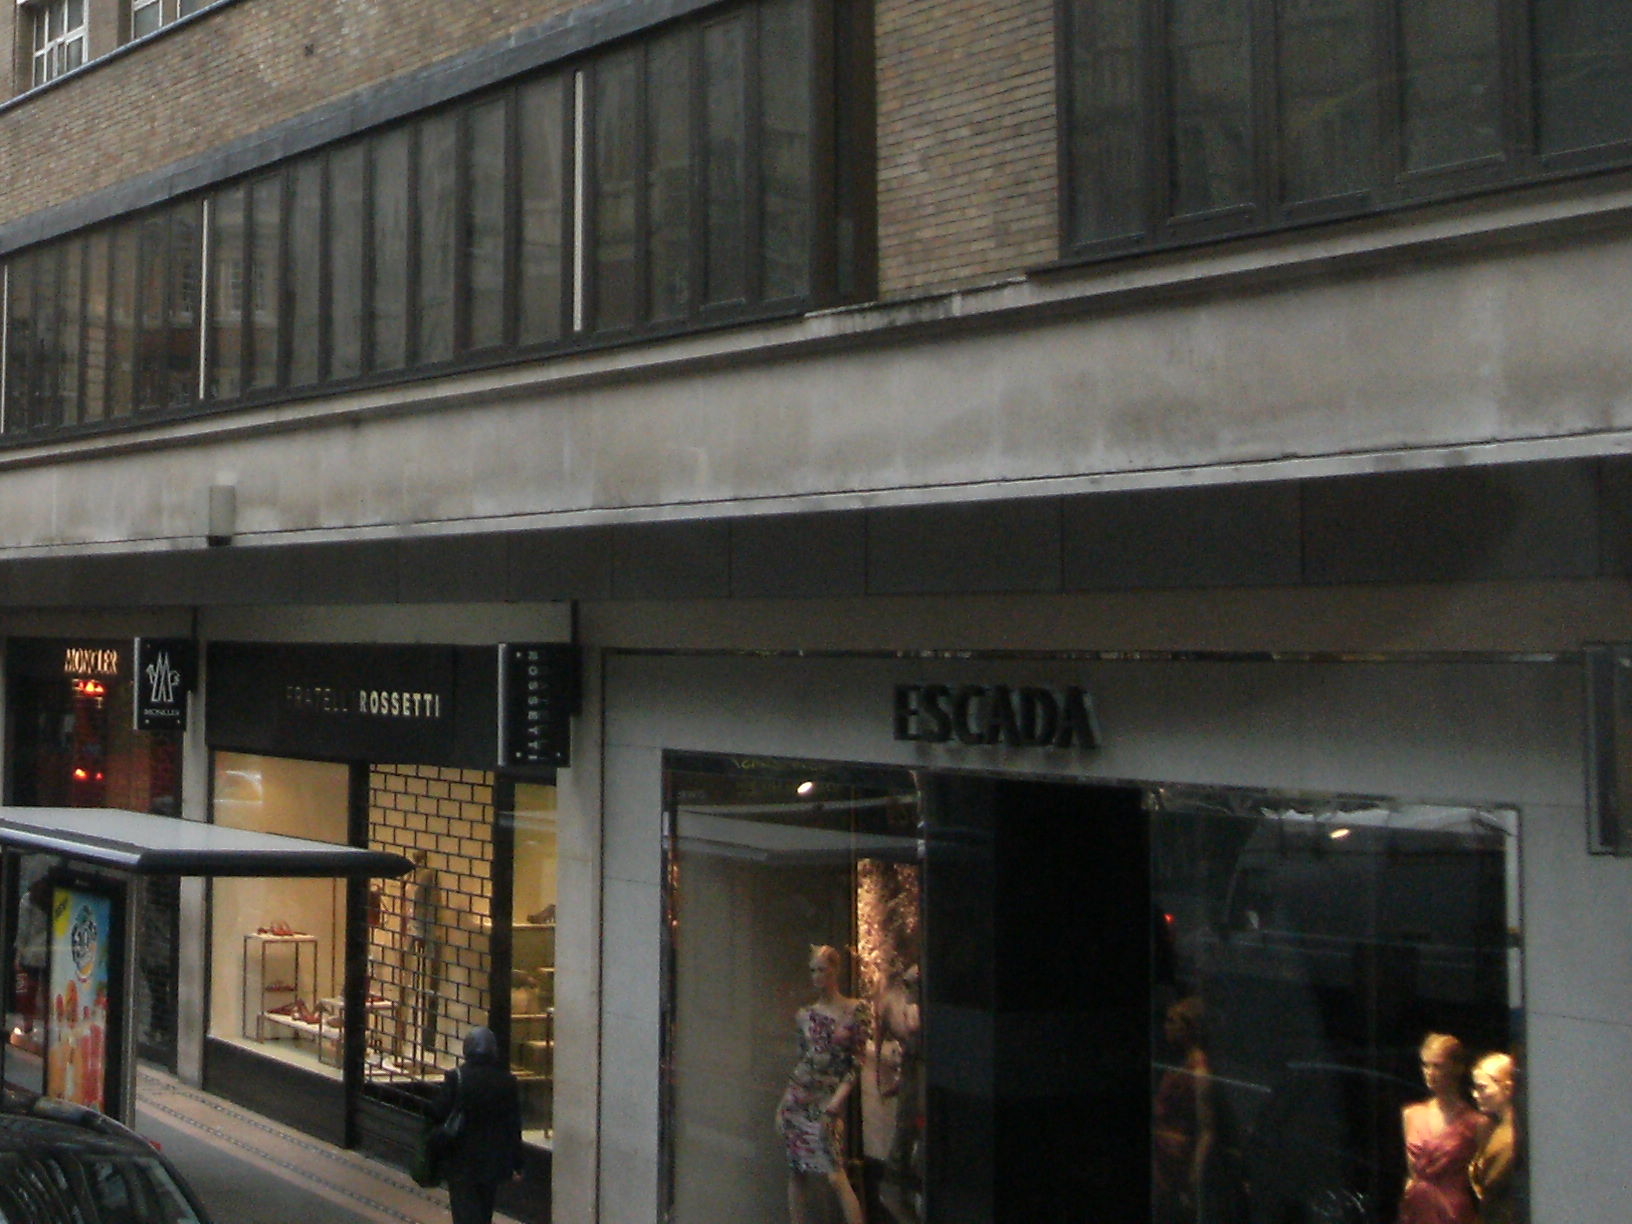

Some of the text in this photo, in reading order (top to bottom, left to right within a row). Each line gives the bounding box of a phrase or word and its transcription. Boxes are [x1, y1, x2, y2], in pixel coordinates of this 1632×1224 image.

[64, 647, 119, 675] MONCLER
[359, 689, 441, 718] ROSSETTI
[893, 683, 1100, 749] ESCADA
